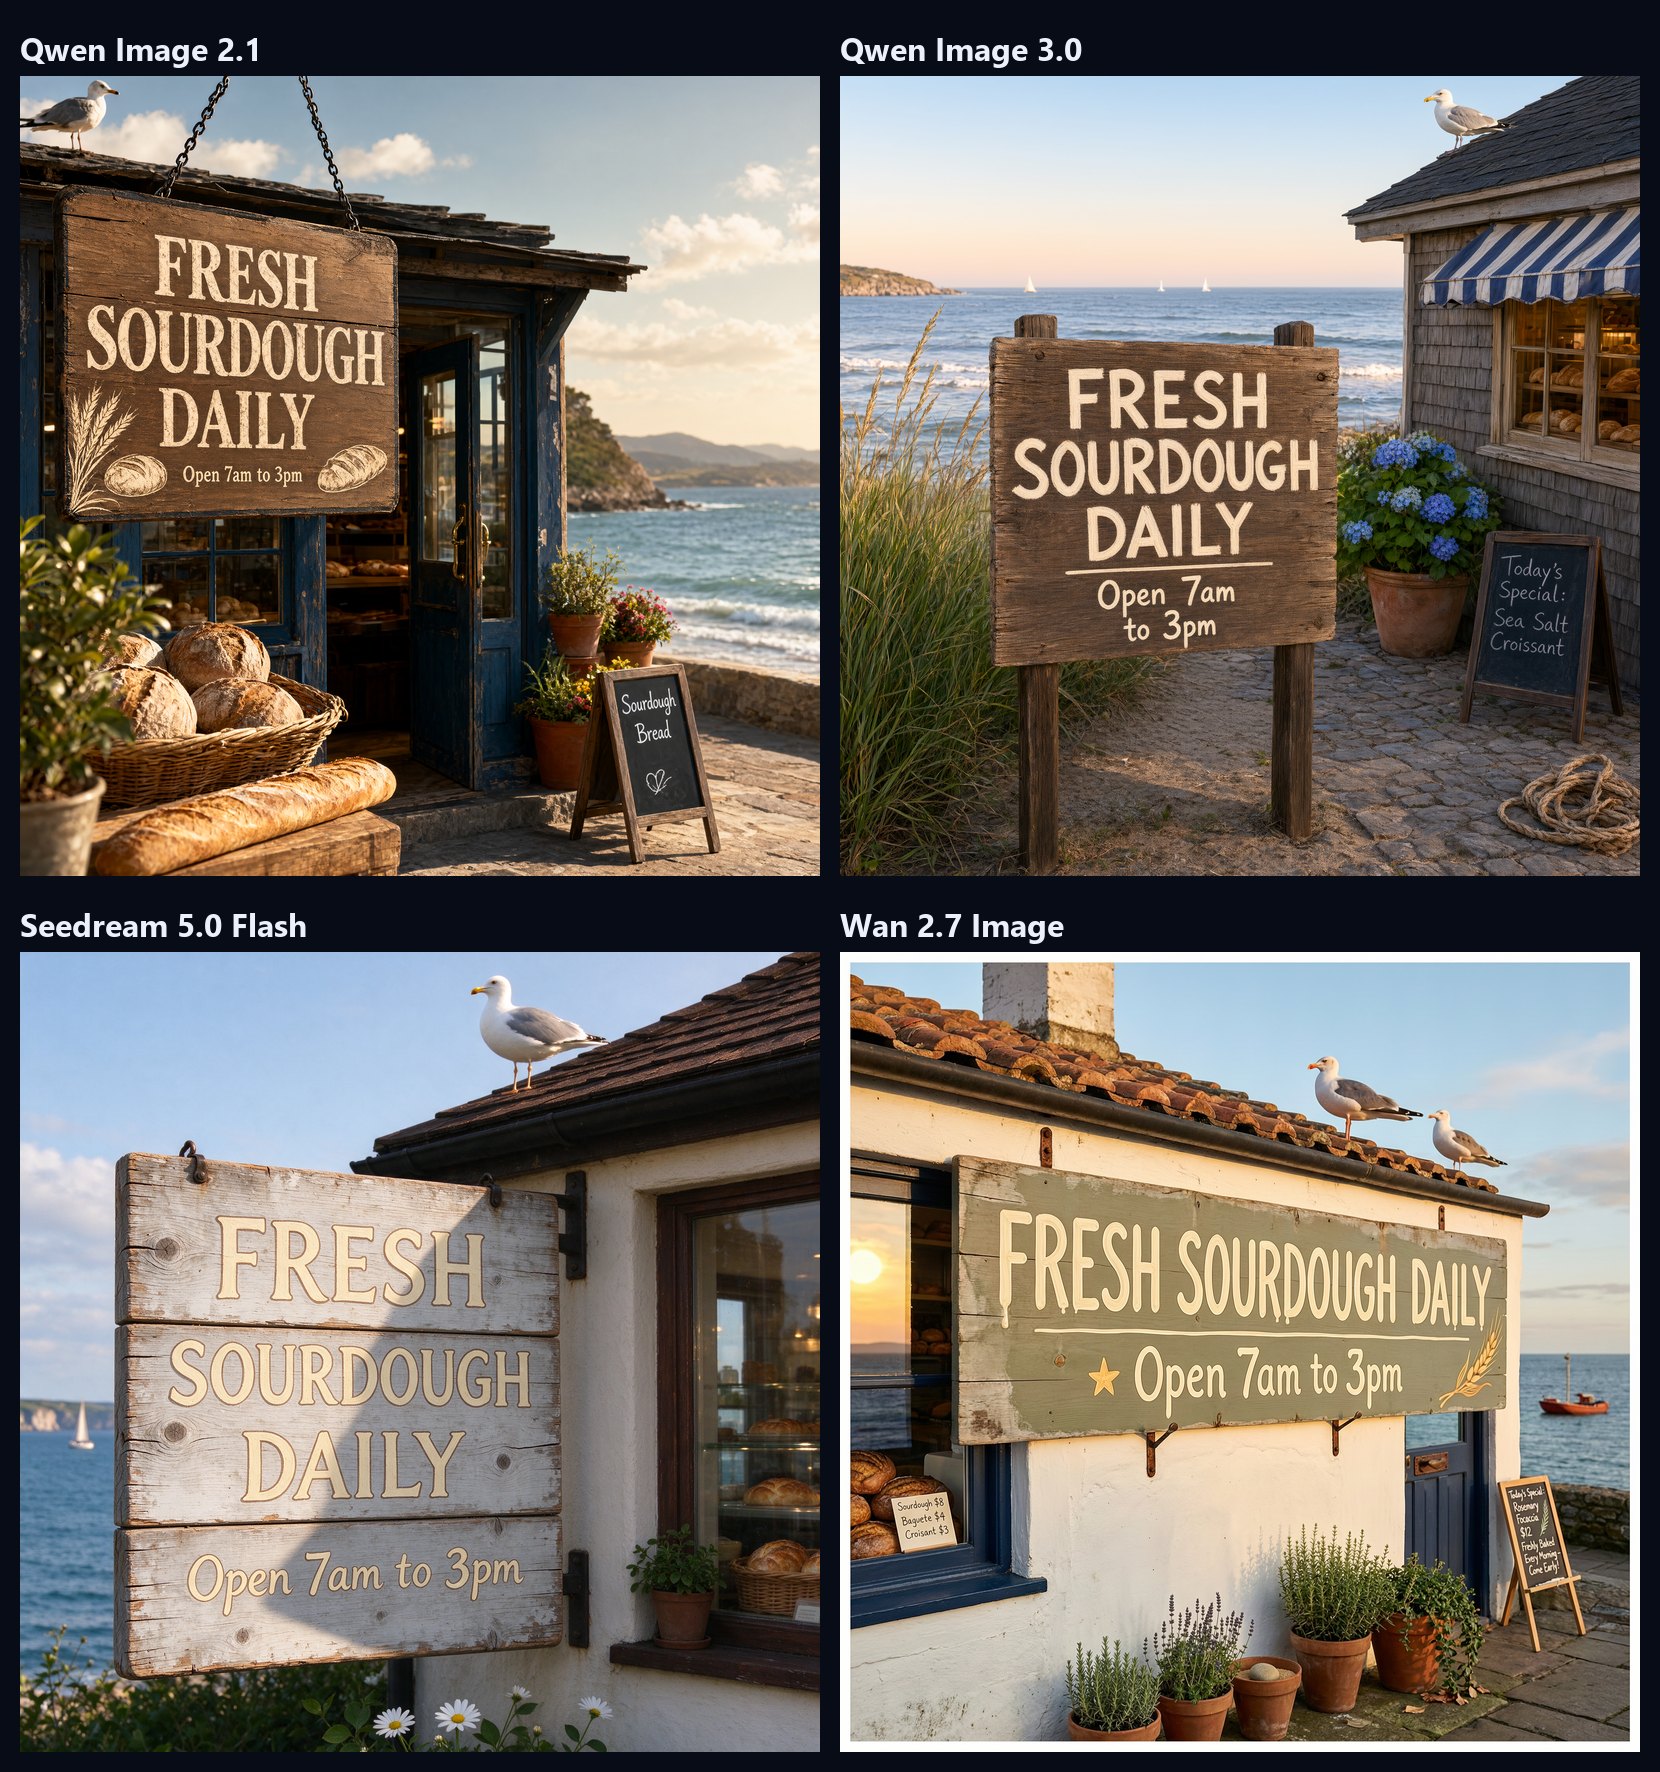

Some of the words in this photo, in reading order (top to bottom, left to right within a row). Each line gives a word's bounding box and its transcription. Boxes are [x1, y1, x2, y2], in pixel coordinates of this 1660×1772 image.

[154, 234, 319, 312] FRESH
[86, 304, 386, 386] SOURDOUGH
[159, 387, 315, 450] DAILY
[1068, 368, 1267, 429] FRESH
[183, 465, 220, 487] Open
[224, 466, 252, 483] 7am
[257, 468, 270, 483] to
[274, 466, 303, 487] 3pm
[1012, 437, 1319, 499] SOURDOUGH
[1087, 502, 1253, 562] DAILY
[1501, 554, 1563, 587] Today's
[1097, 579, 1165, 617] Open
[1181, 575, 1235, 606] 7am
[1499, 580, 1565, 606] Special:
[1123, 618, 1149, 642] to
[1163, 609, 1216, 649] 3pm
[1493, 608, 1525, 628] Sea
[1533, 612, 1568, 634] Salt
[1490, 631, 1565, 657] Croissant
[621, 687, 677, 715] Sourdough
[634, 719, 672, 744] Bread
[216, 1215, 487, 1308] FRESH
[999, 1209, 1161, 1329] FRESH
[1177, 1230, 1396, 1324] SOURDOUGH
[1411, 1259, 1493, 1331] DAILY
[169, 1339, 531, 1408] SOURDOUGH
[1134, 1345, 1227, 1418] Open
[1237, 1346, 1302, 1399] 7am
[1310, 1353, 1338, 1394] to
[1346, 1348, 1403, 1409] 3pm
[241, 1430, 467, 1502] DAILY
[897, 1499, 933, 1511] Sourdough
[934, 1497, 945, 1508] $8
[934, 1511, 946, 1522] $4
[1512, 1501, 1539, 1513] Rosemary
[905, 1526, 937, 1539] Croisant
[938, 1524, 950, 1536] $3
[1520, 1526, 1533, 1539] $12
[187, 1553, 294, 1616] Open
[304, 1550, 383, 1596] 7am
[396, 1553, 432, 1588] to
[445, 1546, 525, 1601] 3pm
